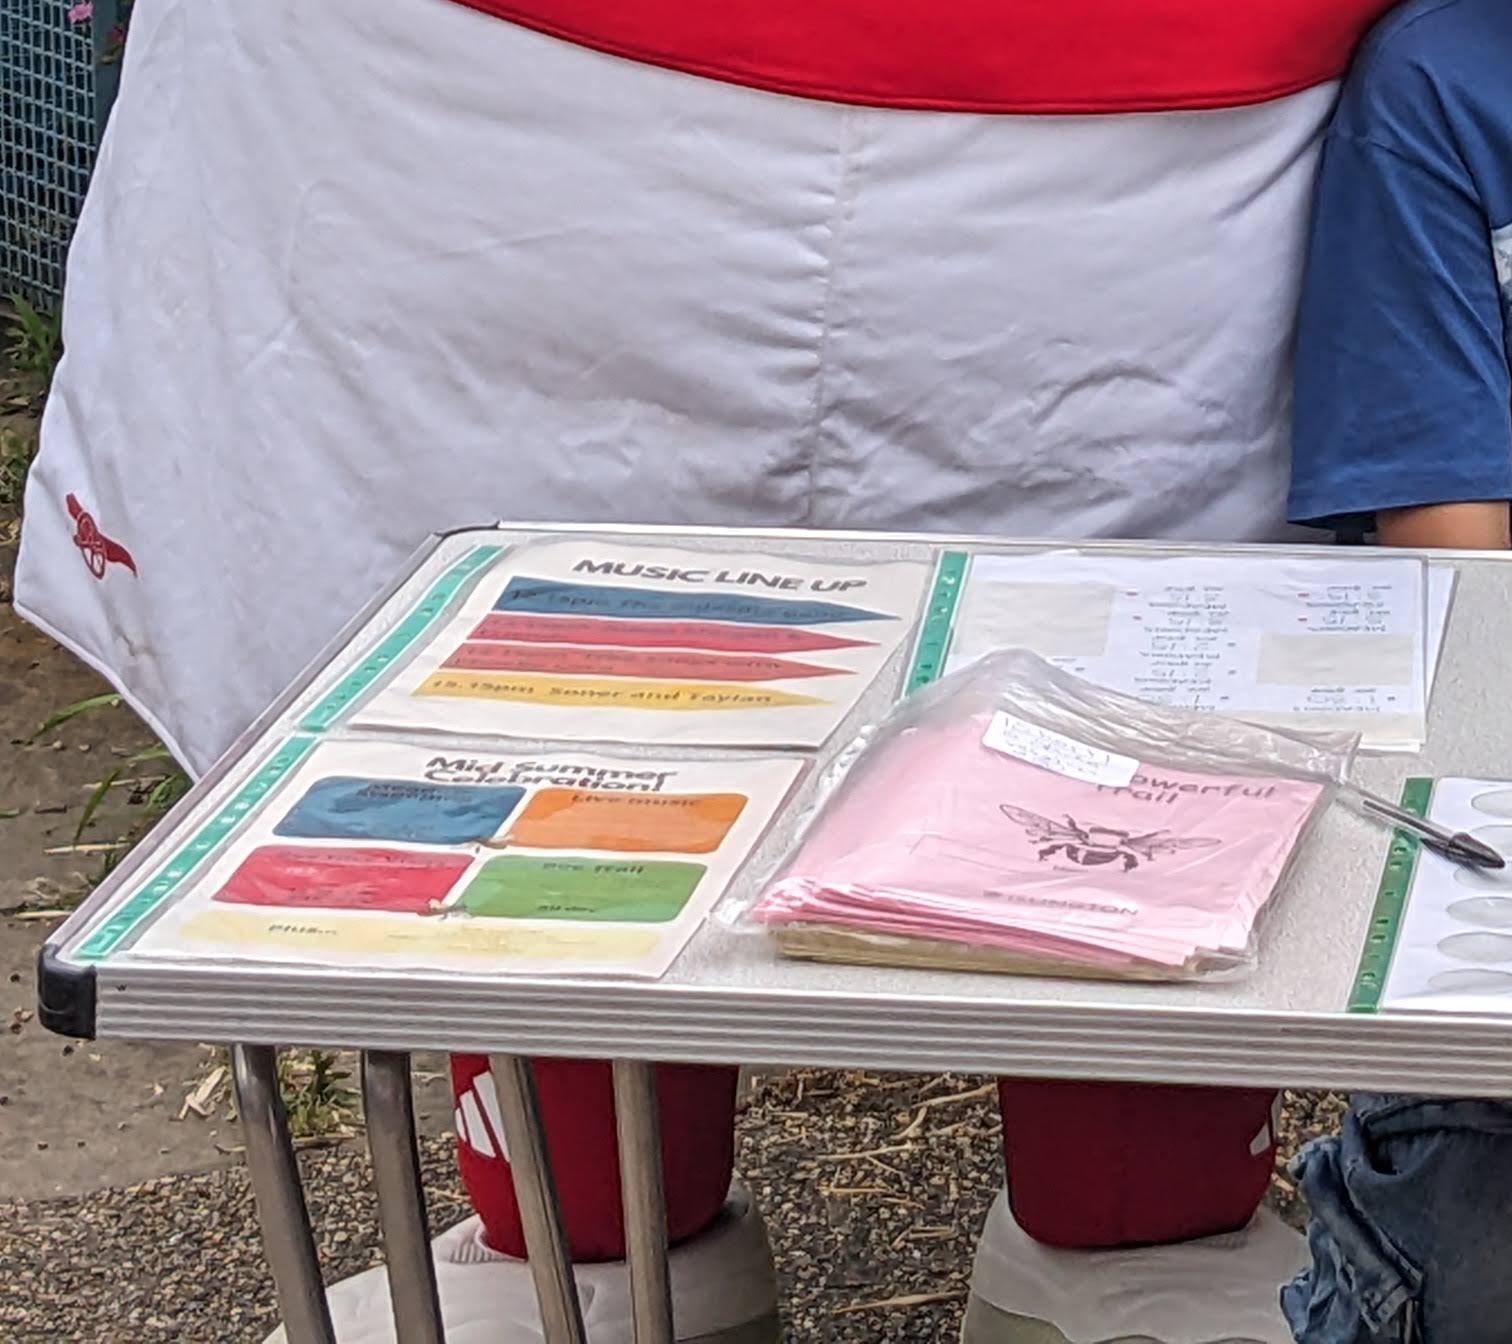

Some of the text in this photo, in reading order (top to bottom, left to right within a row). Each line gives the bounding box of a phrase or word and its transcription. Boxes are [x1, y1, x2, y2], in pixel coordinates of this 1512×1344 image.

[573, 559, 869, 592] MUSIC LINE UP
[423, 769, 672, 792] Celebration!
[425, 756, 679, 783] Mid Summer
[1097, 784, 1180, 804] rail
[1130, 774, 1276, 799] owerful
